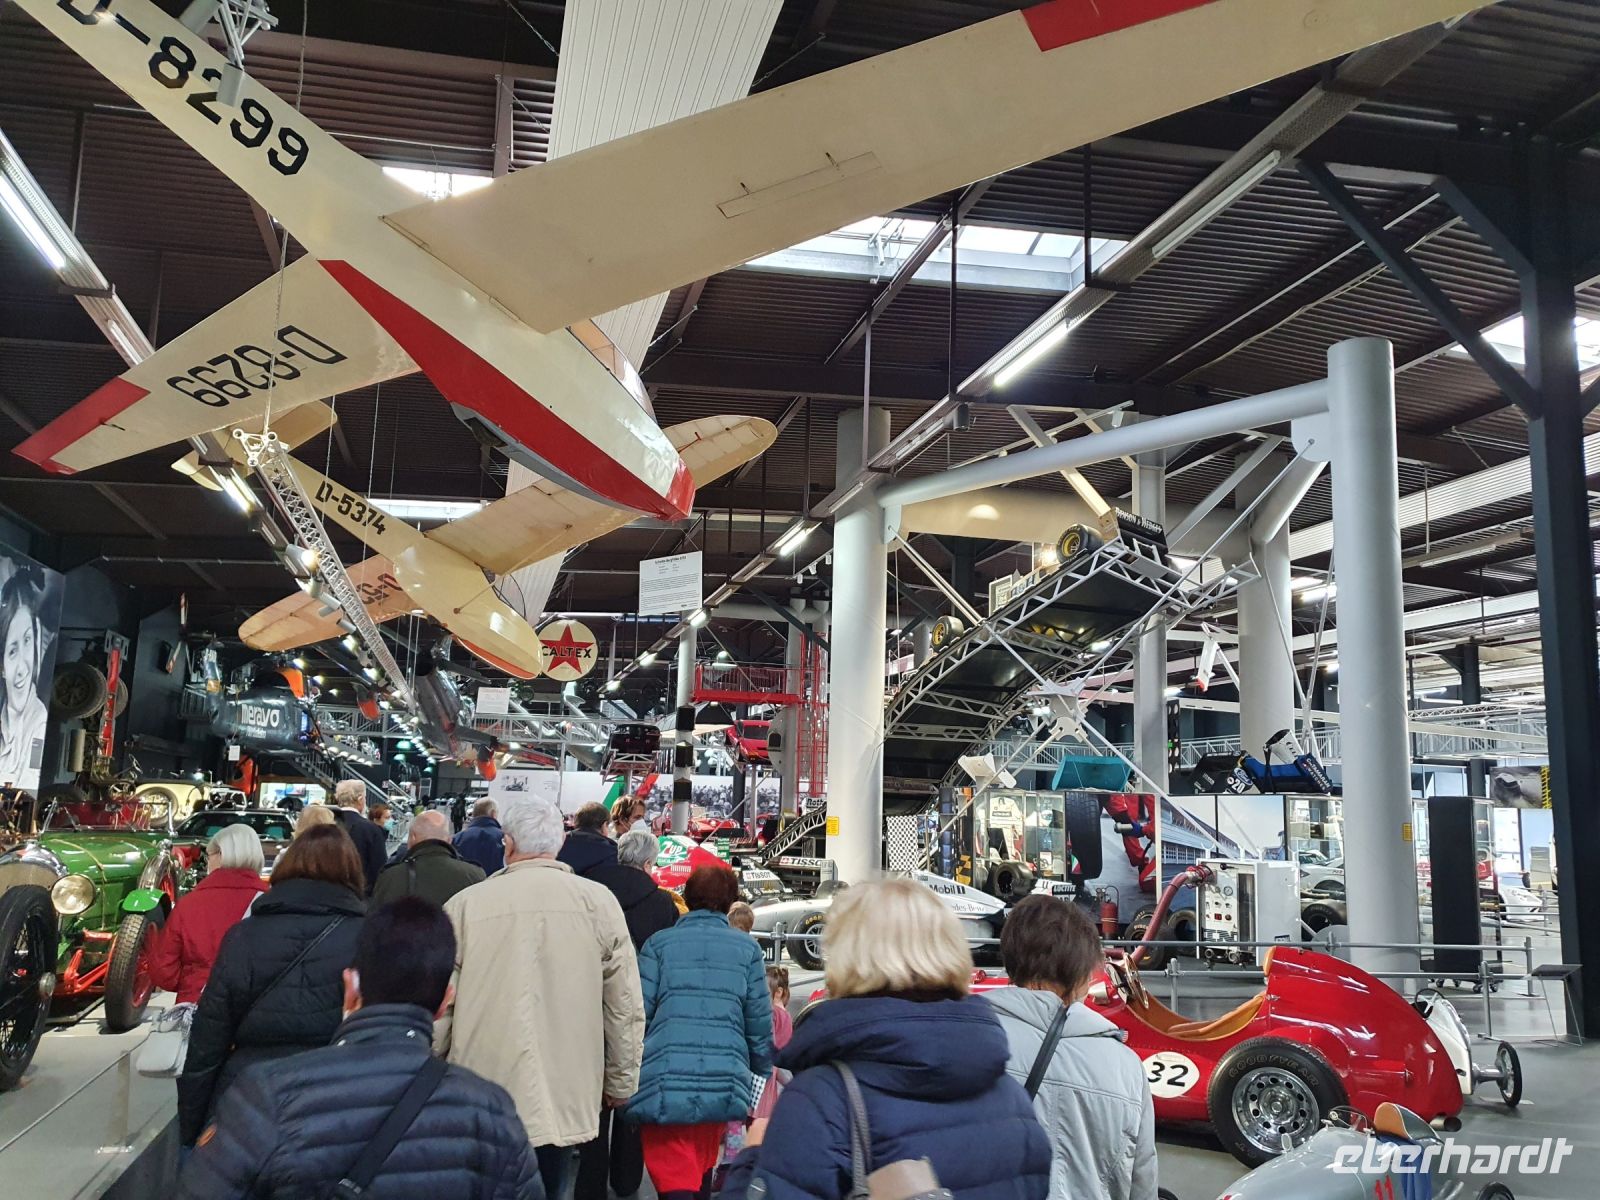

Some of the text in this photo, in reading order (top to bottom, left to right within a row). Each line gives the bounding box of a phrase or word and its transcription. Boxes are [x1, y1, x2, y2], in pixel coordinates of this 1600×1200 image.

[167, 325, 348, 407] D-8299
[315, 480, 386, 535] D-5374
[541, 645, 592, 659] CALTEX
[1231, 778, 1246, 794] 20
[751, 871, 771, 879] TISSOT
[929, 884, 956, 895] Mobil
[1148, 1061, 1189, 1087] 32
[1229, 1053, 1320, 1088] GOODYEAR
